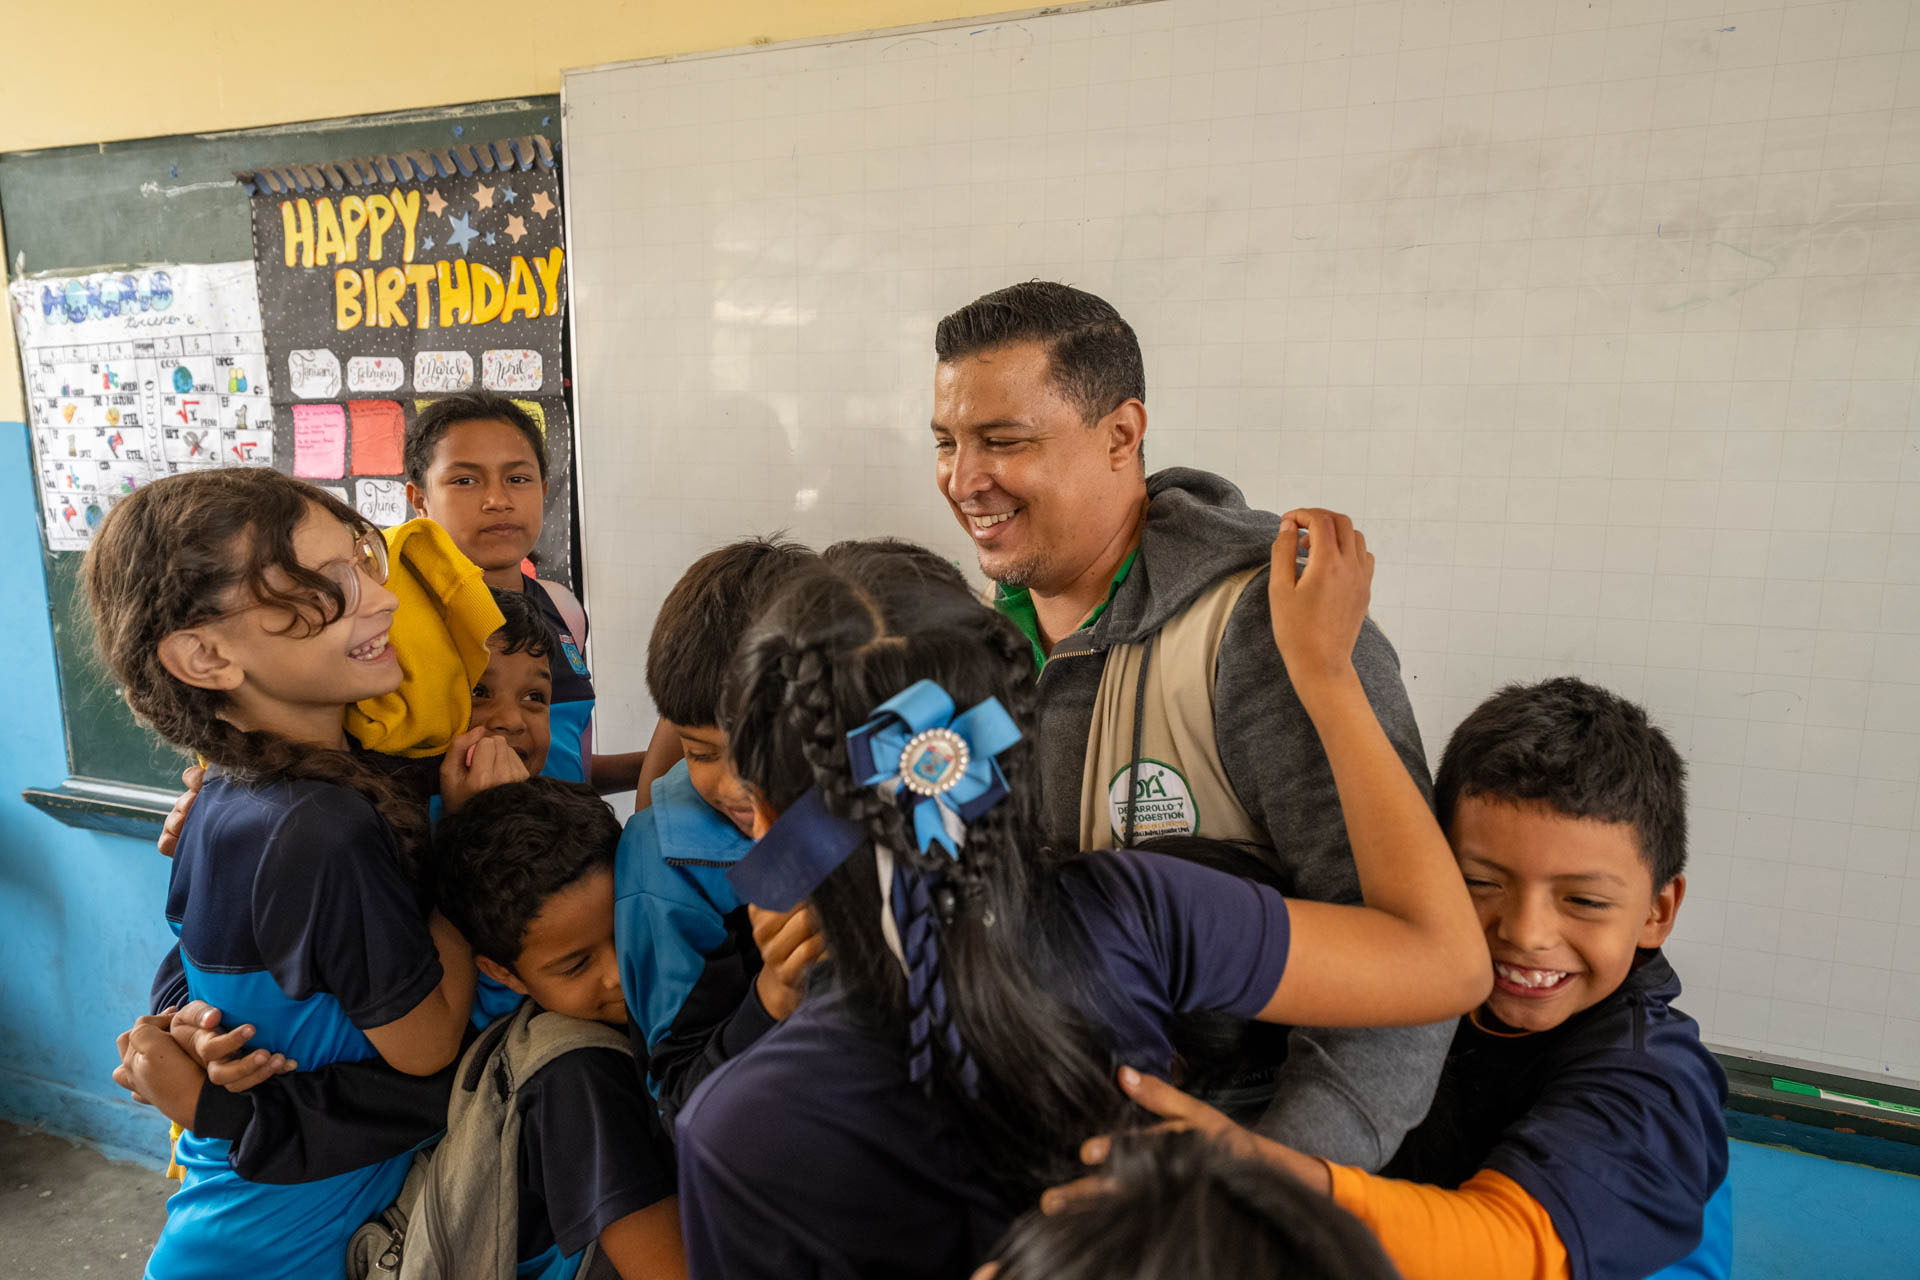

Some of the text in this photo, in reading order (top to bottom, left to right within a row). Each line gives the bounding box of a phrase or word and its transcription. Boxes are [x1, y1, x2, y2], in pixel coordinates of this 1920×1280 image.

[280, 187, 420, 268] HAPPY
[335, 246, 565, 331] BIRTHDAY
[291, 351, 339, 397] January
[350, 366, 397, 386] February
[422, 358, 465, 388] March
[492, 358, 526, 387] April
[360, 481, 398, 521] June
[1118, 802, 1184, 816] DEARROLLO Y
[1120, 812, 1185, 824] ATOGESTION
